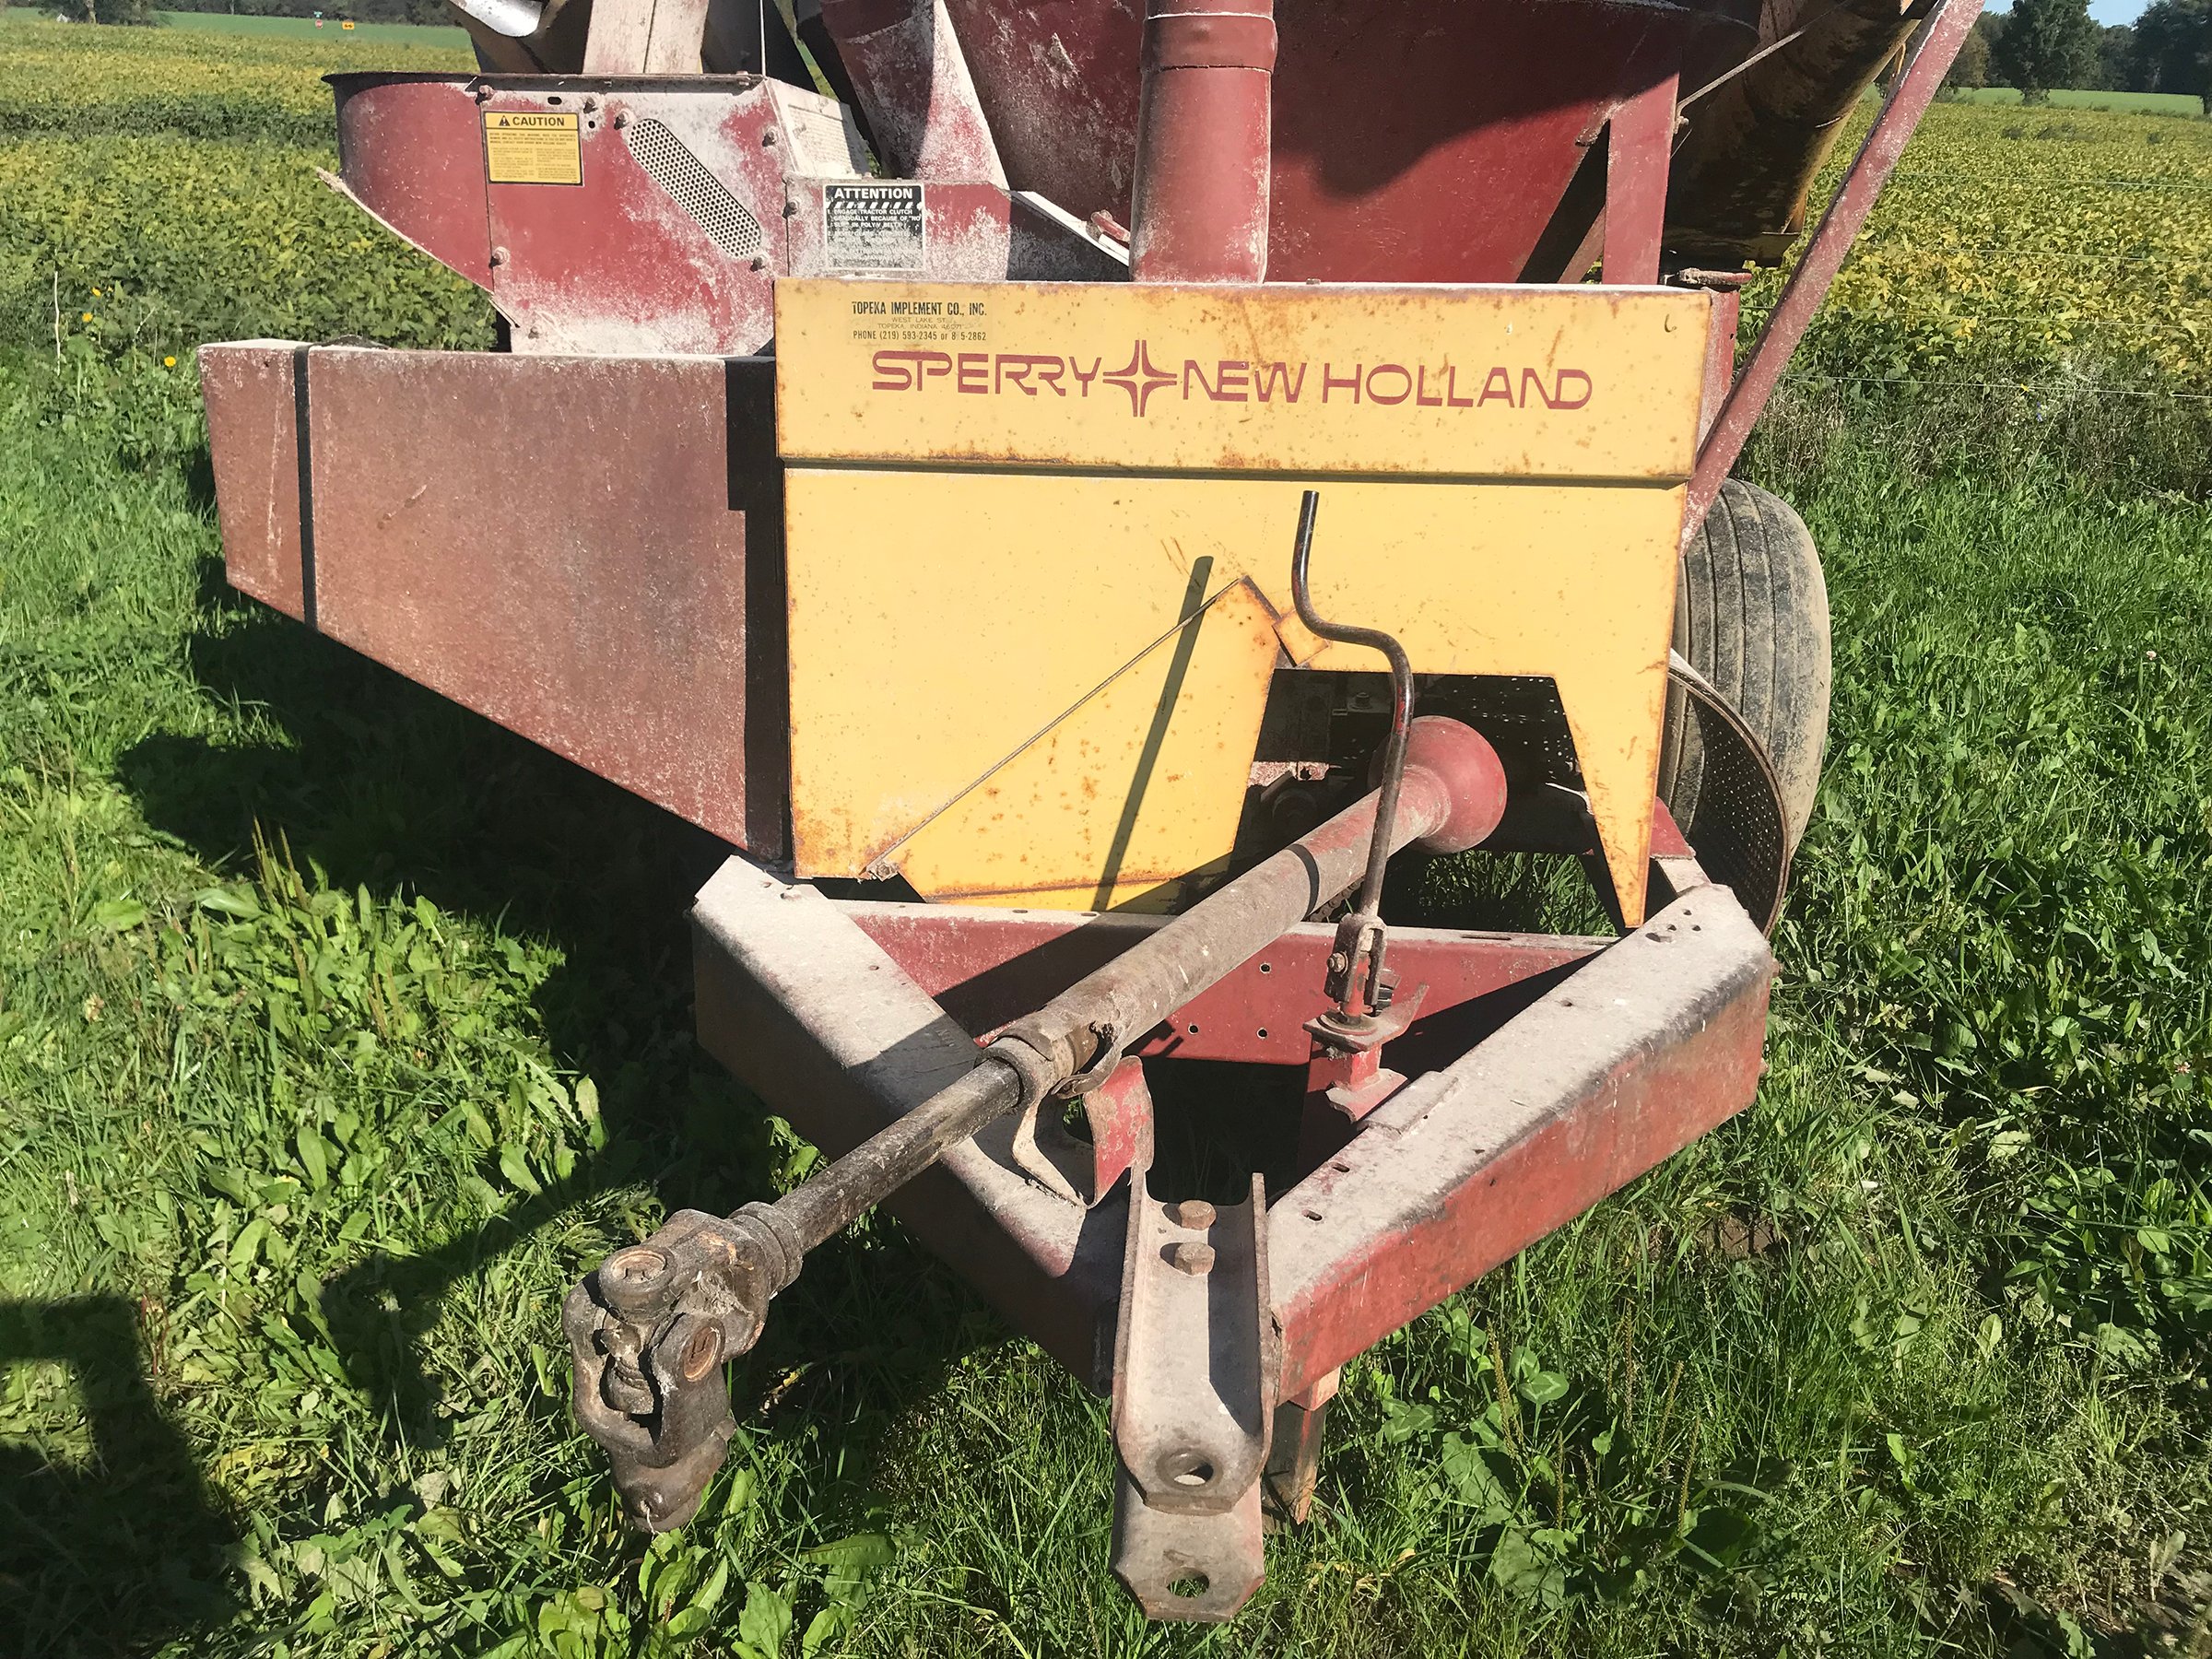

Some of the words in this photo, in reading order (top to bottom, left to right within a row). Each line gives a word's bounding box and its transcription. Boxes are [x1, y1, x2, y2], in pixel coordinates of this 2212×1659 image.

[512, 117, 565, 126] CAUTION
[835, 188, 913, 199] ATTENTION
[852, 301, 886, 314] TOPEKA
[891, 302, 943, 315] IMPLEMENT
[947, 302, 965, 317] CO.,
[969, 303, 987, 316] INC.
[853, 331, 877, 340] PHONE
[879, 331, 899, 340] (219)
[903, 332, 937, 340] 593-2345
[872, 350, 1102, 397] SPERRY
[1183, 359, 1306, 403] NEW
[1322, 364, 1592, 410] HOLLAND
